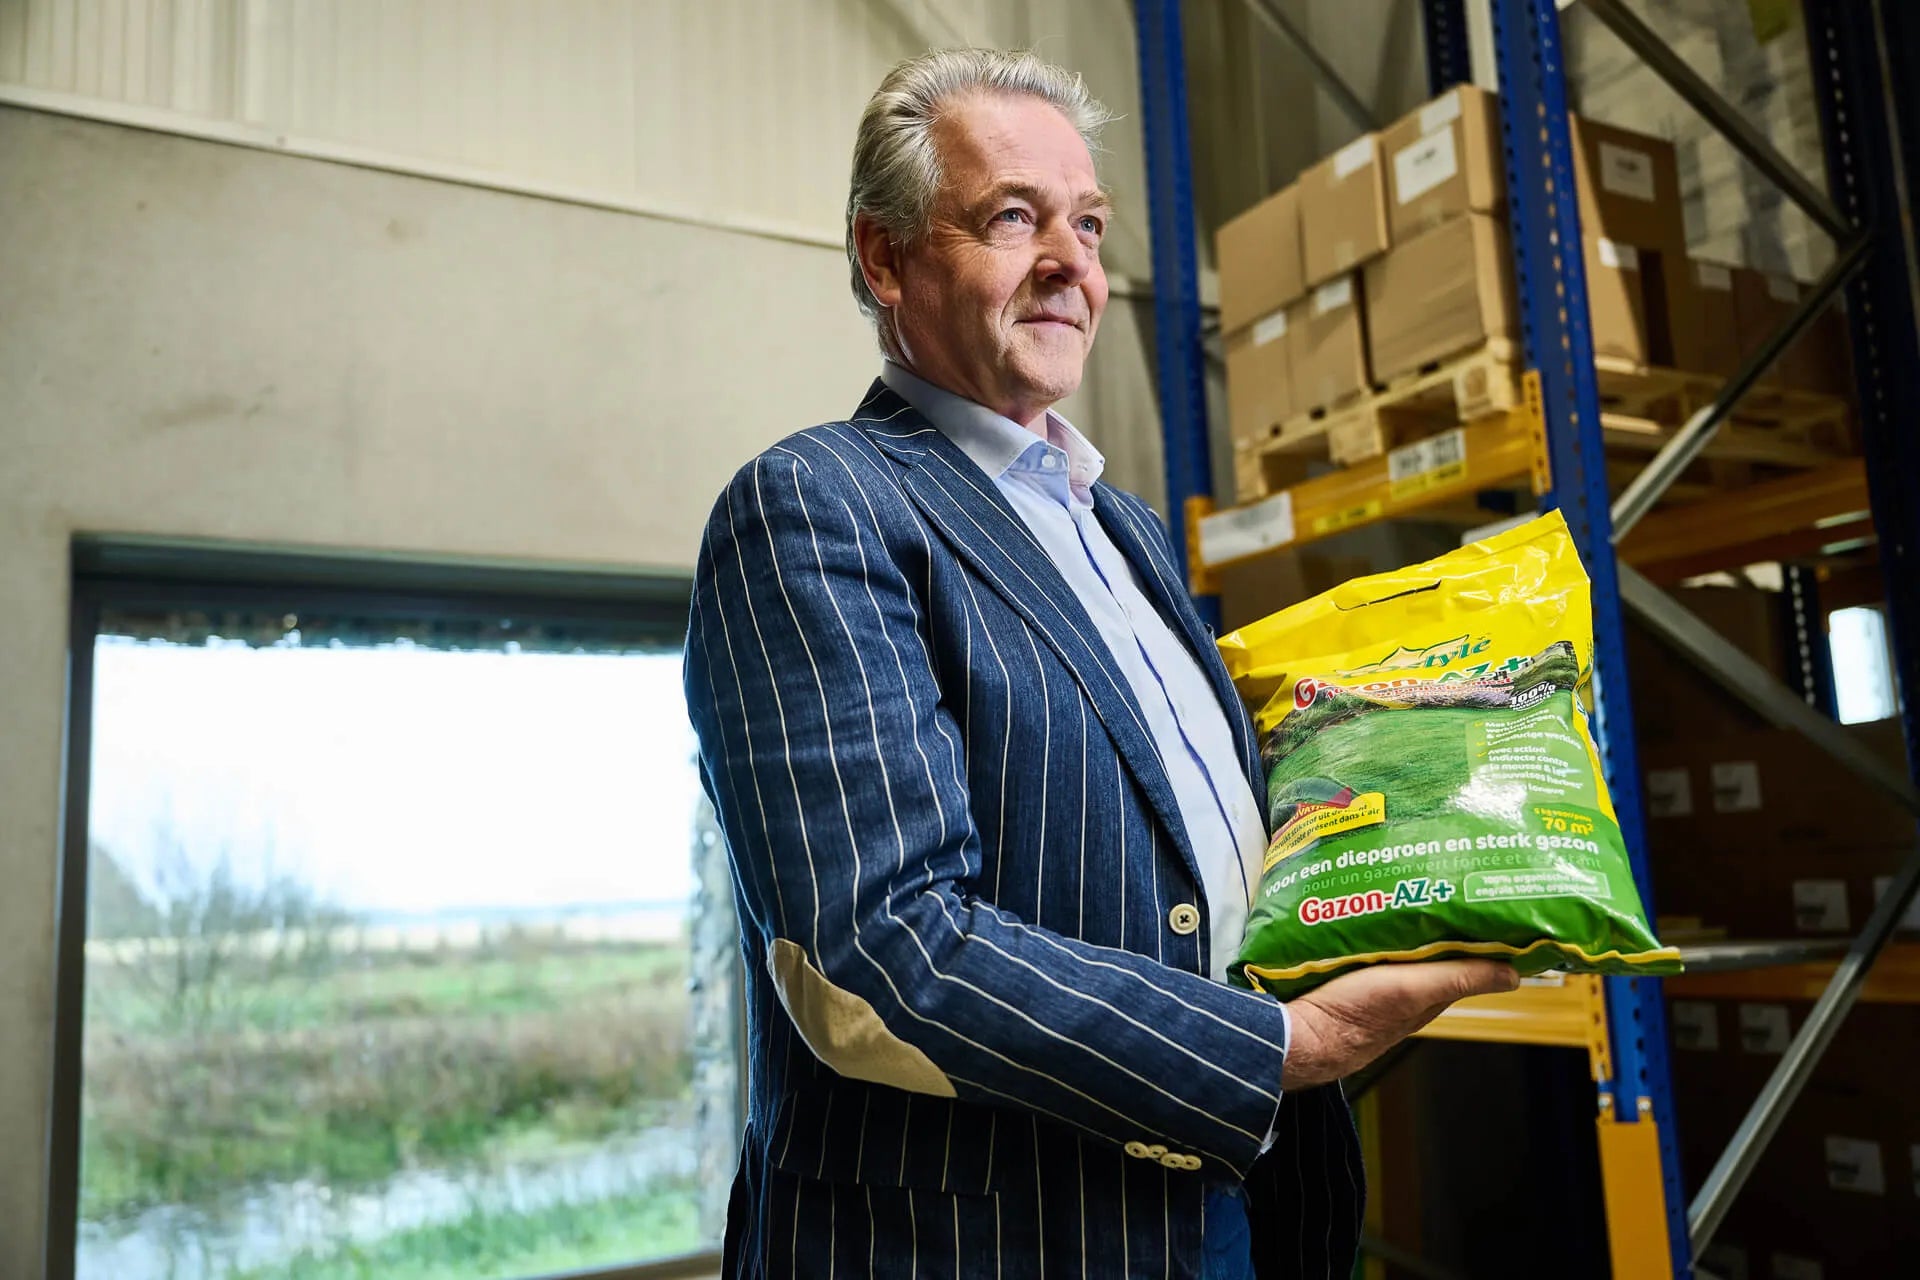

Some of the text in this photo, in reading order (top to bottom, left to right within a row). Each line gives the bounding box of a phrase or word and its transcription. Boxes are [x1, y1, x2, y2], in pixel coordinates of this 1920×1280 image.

[1509, 682, 1556, 705] 100%
[1513, 745, 1546, 754] action
[1537, 755, 1569, 768] contre
[1318, 809, 1331, 821] uit
[1339, 812, 1360, 824] dans
[1542, 816, 1567, 833] 70
[1264, 832, 1600, 898] voor een diepgroen en sterk gazon
[1302, 875, 1337, 896] pour
[1340, 871, 1360, 885] un
[1363, 862, 1412, 883] gazon
[1416, 857, 1449, 873] vert
[1454, 852, 1500, 869] foncé
[1505, 852, 1521, 865] et
[1475, 884, 1514, 897] engrais
[1514, 883, 1545, 893] 100%
[1299, 877, 1455, 925] Gazon-AZ+
